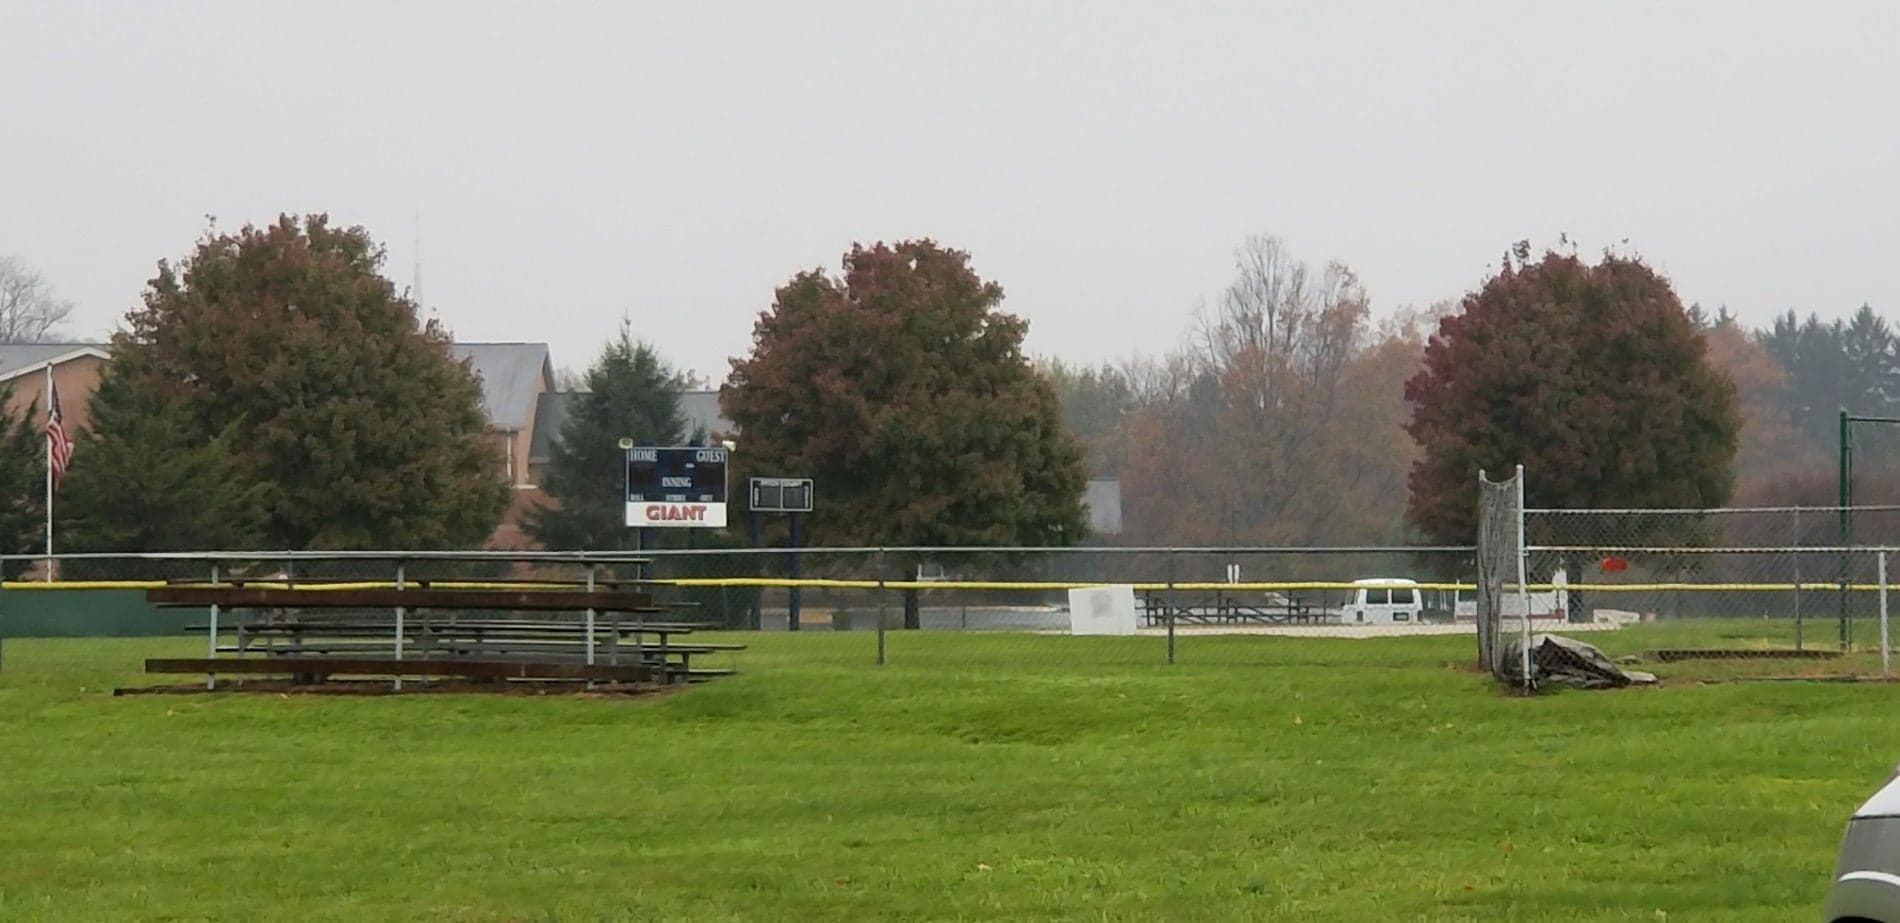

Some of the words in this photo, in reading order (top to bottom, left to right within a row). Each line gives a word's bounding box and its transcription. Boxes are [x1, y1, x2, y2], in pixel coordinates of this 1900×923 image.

[630, 450, 658, 462] HOME
[696, 450, 725, 462] GUEST
[646, 505, 707, 520] GIANT
